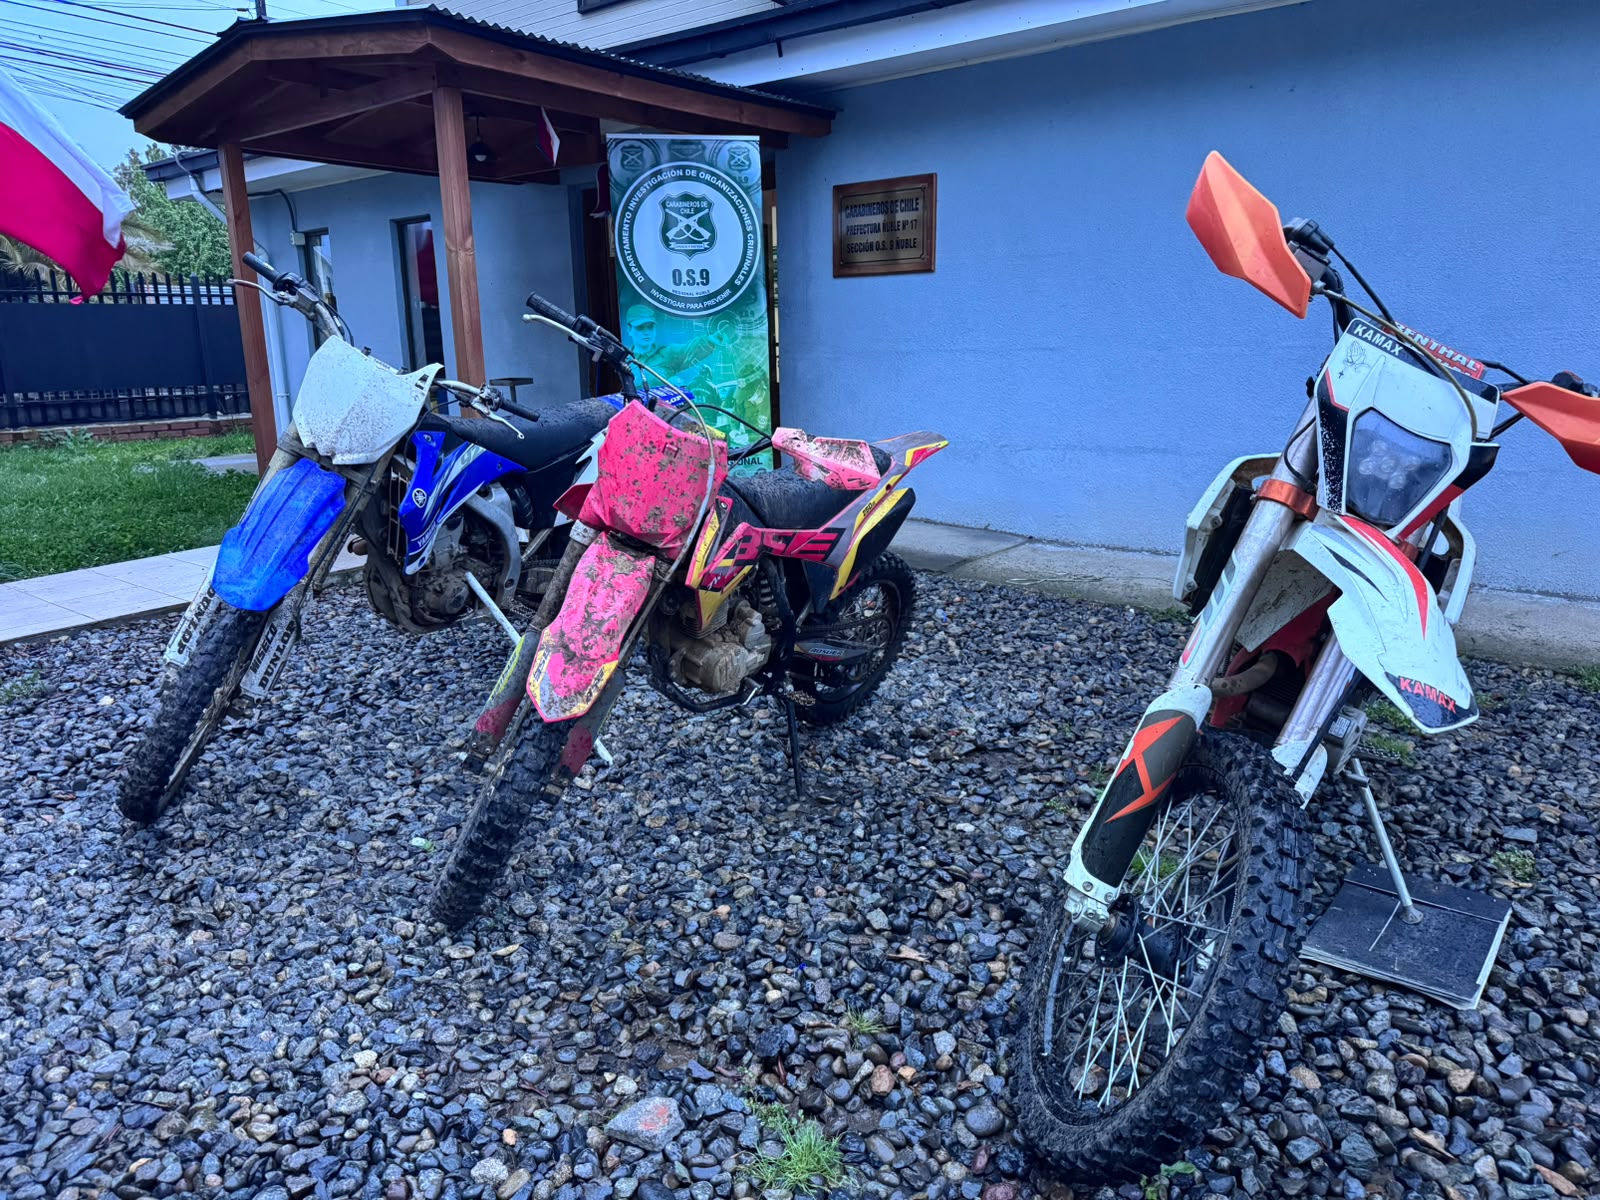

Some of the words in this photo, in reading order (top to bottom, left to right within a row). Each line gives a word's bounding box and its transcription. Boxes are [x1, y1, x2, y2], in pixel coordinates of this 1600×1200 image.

[630, 169, 683, 211] INVESTIGACIÓN
[685, 169, 697, 177] DE
[699, 171, 753, 231] ORGANIZACIONES
[845, 202, 889, 218] CARABINEROS
[890, 200, 899, 214] DE
[900, 198, 919, 213] CHILE
[846, 222, 881, 236] PREFECTURA
[882, 219, 900, 232] ÑUBLE
[910, 219, 917, 230] 17
[621, 211, 645, 283] DEPARTAMENTO
[735, 233, 754, 286] CRIMINALES
[847, 239, 874, 254] SECCIÓN
[895, 237, 917, 250] ÑUBLE
[672, 268, 710, 286] O.S.9
[650, 288, 686, 309] INVESTIGAR
[686, 301, 704, 309] PARA
[704, 289, 732, 308] PREVENIR
[1354, 324, 1403, 357] KAMAX
[250, 623, 278, 674] WISECO
[258, 620, 295, 690] DUNLOP
[1399, 677, 1457, 714] KAMAX
